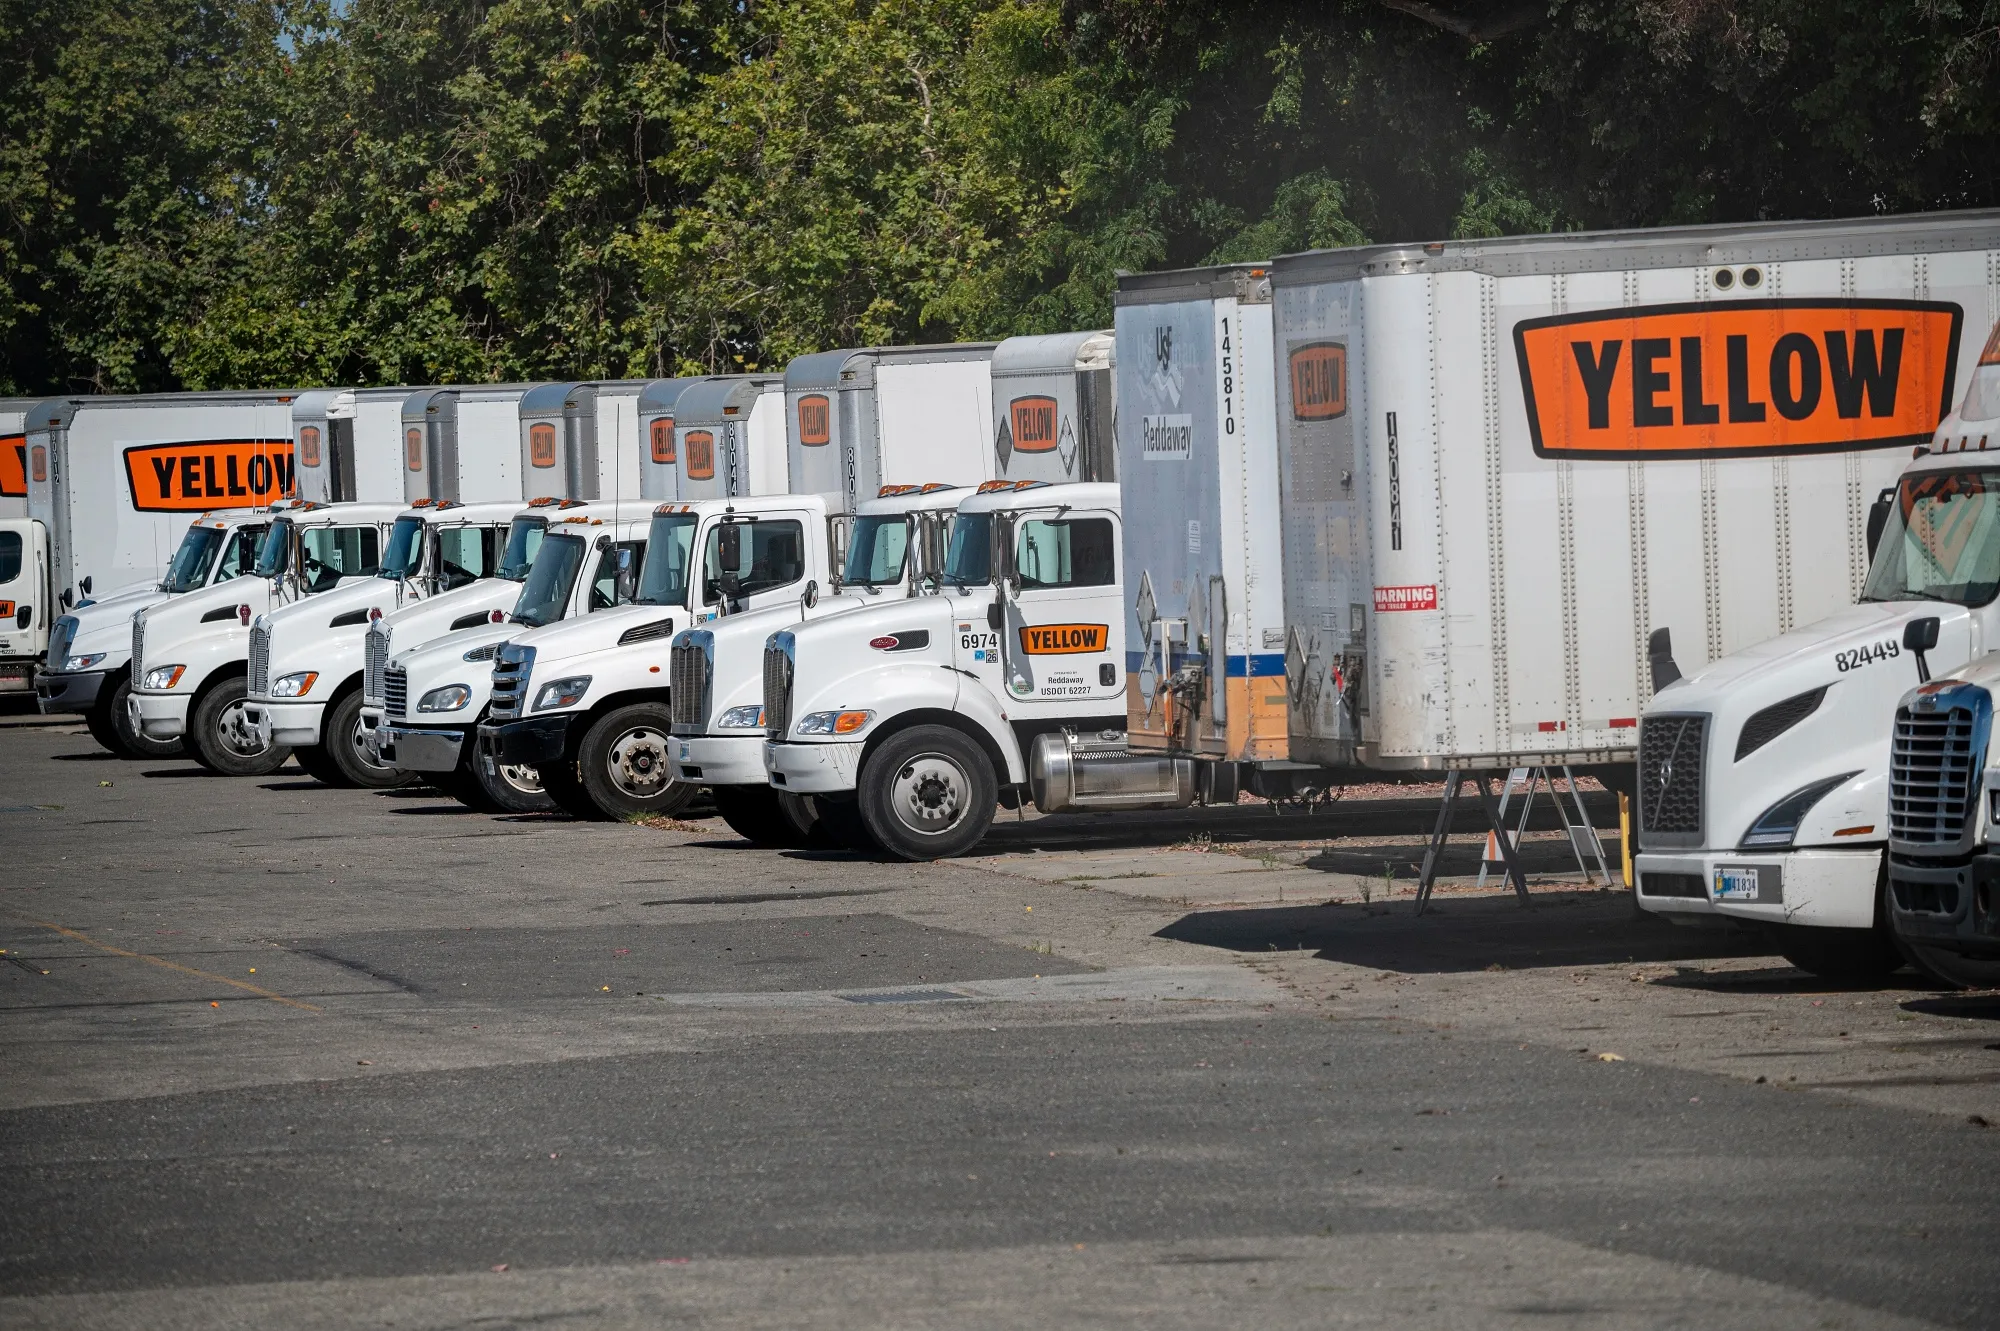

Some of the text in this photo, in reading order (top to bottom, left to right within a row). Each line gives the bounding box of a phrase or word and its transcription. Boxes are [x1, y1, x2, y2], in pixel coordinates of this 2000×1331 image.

[1221, 317, 1235, 435] 145810
[1297, 356, 1339, 405] YELLOW
[1571, 327, 1905, 430] YELLOW
[802, 405, 826, 436] YELLOW
[1016, 407, 1052, 441] YELLOW
[1143, 416, 1191, 460] Reddaway
[688, 440, 711, 470] YELLOW
[728, 421, 738, 496] 80044
[1387, 412, 1401, 550] 130841
[1375, 588, 1434, 602] WARNING
[961, 633, 997, 649] 6974
[1030, 629, 1098, 649] YELLOW
[1835, 639, 1900, 672] 82449
[987, 653, 997, 662] 26
[1041, 686, 1091, 695] USDOT 62227
